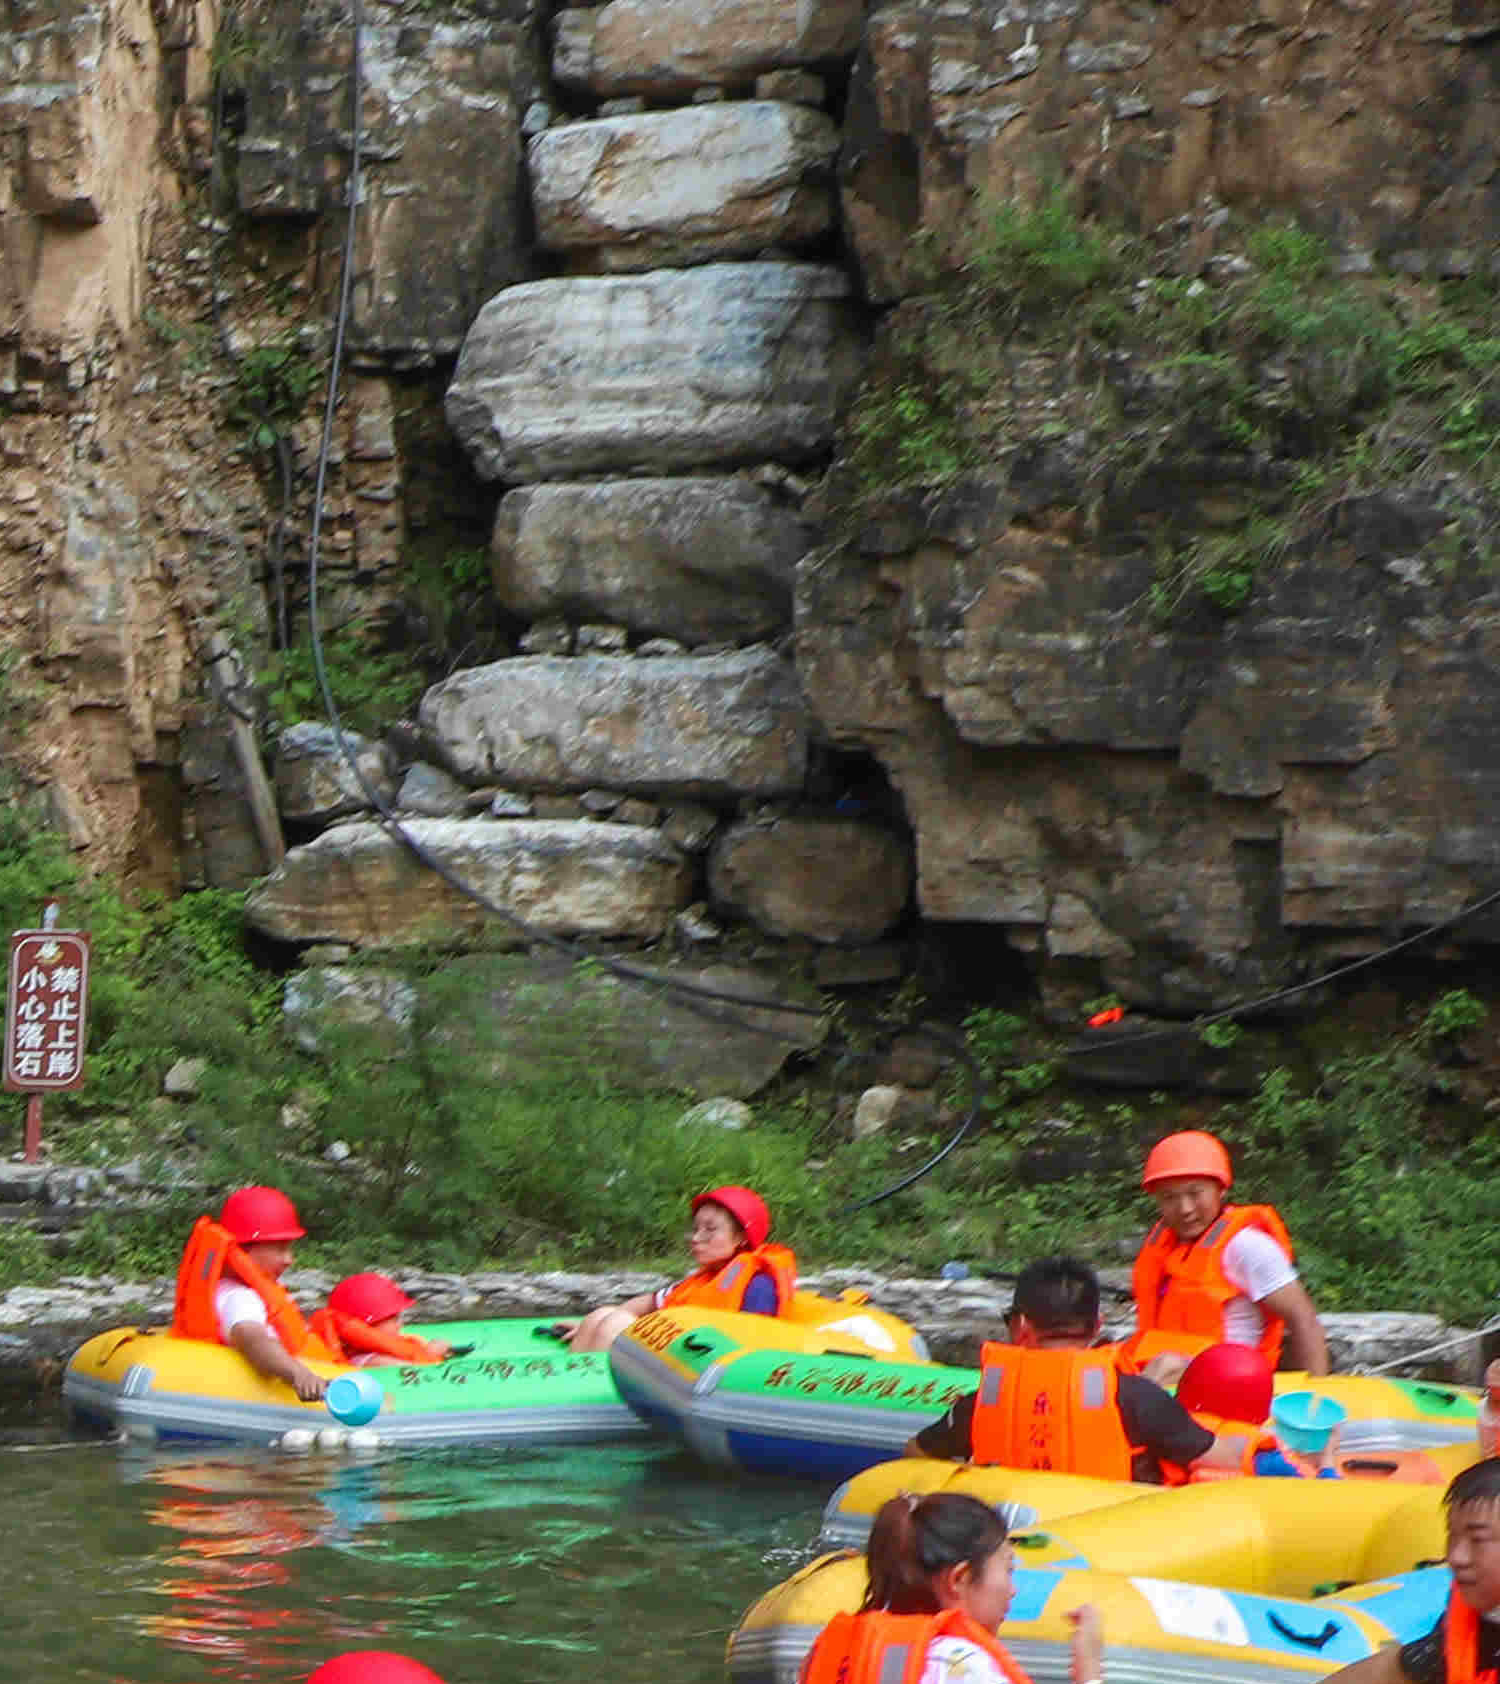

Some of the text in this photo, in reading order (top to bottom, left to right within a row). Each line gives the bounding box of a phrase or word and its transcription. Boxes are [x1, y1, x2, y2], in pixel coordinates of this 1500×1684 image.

[13, 965, 48, 1077] 小心落石
[46, 966, 80, 1078] 禁止上岸
